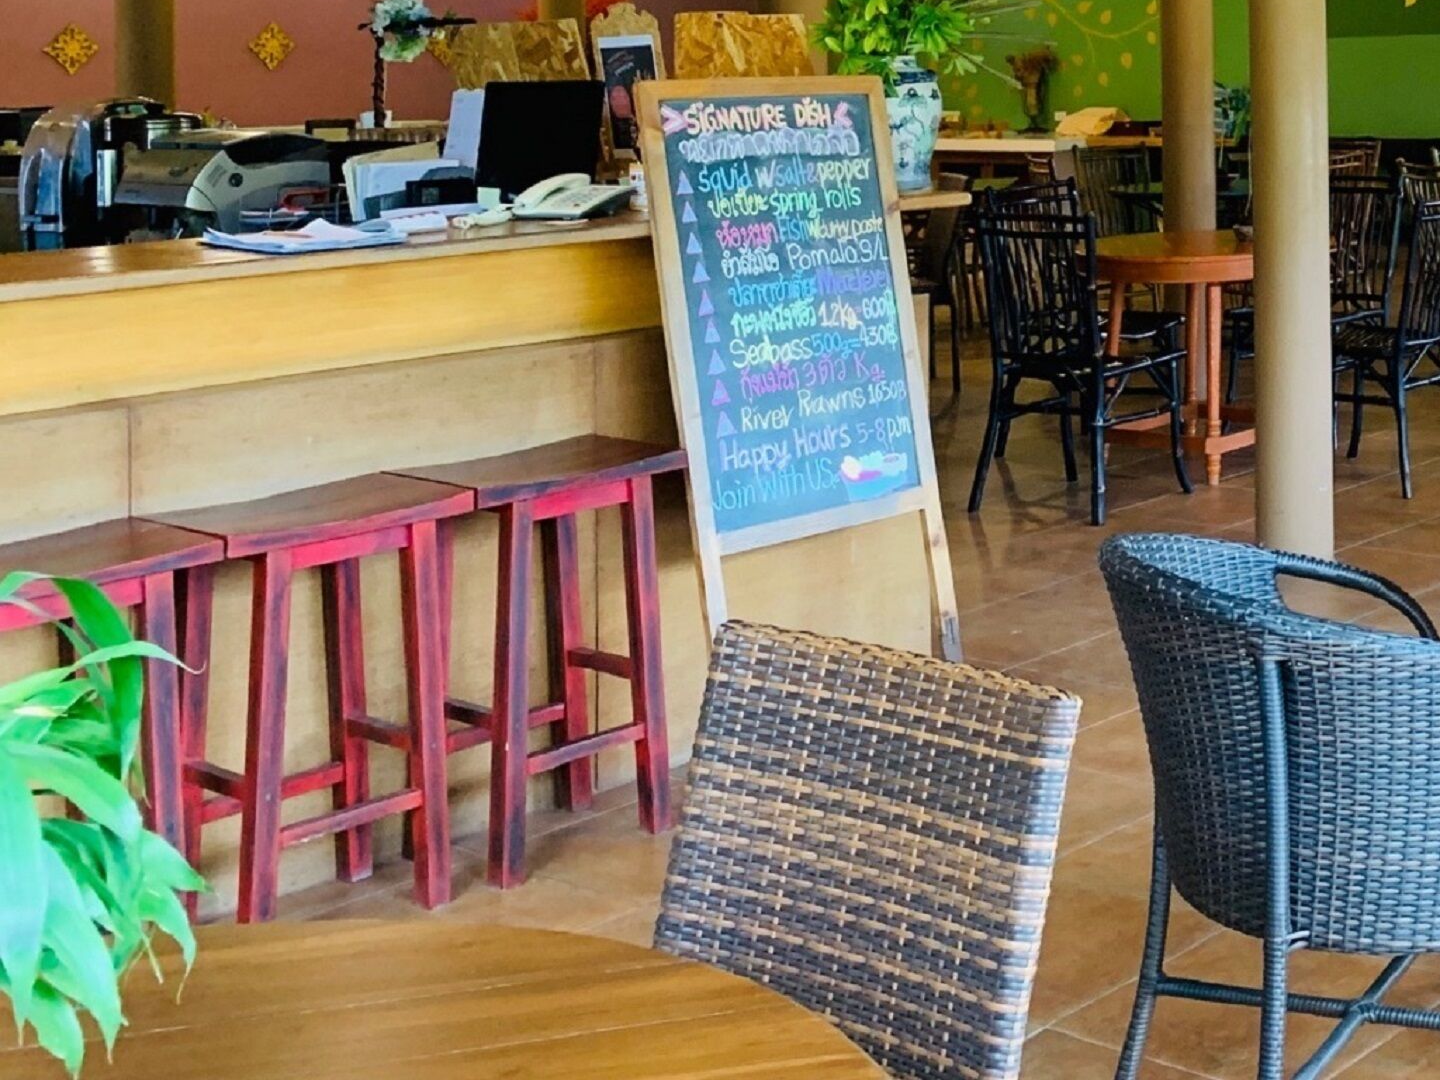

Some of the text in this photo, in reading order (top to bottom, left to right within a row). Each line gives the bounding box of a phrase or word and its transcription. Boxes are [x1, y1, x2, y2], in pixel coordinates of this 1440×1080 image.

[741, 403, 795, 433] River
[719, 437, 793, 474] Happy
[793, 424, 851, 458] Hours
[713, 478, 756, 511] Join
